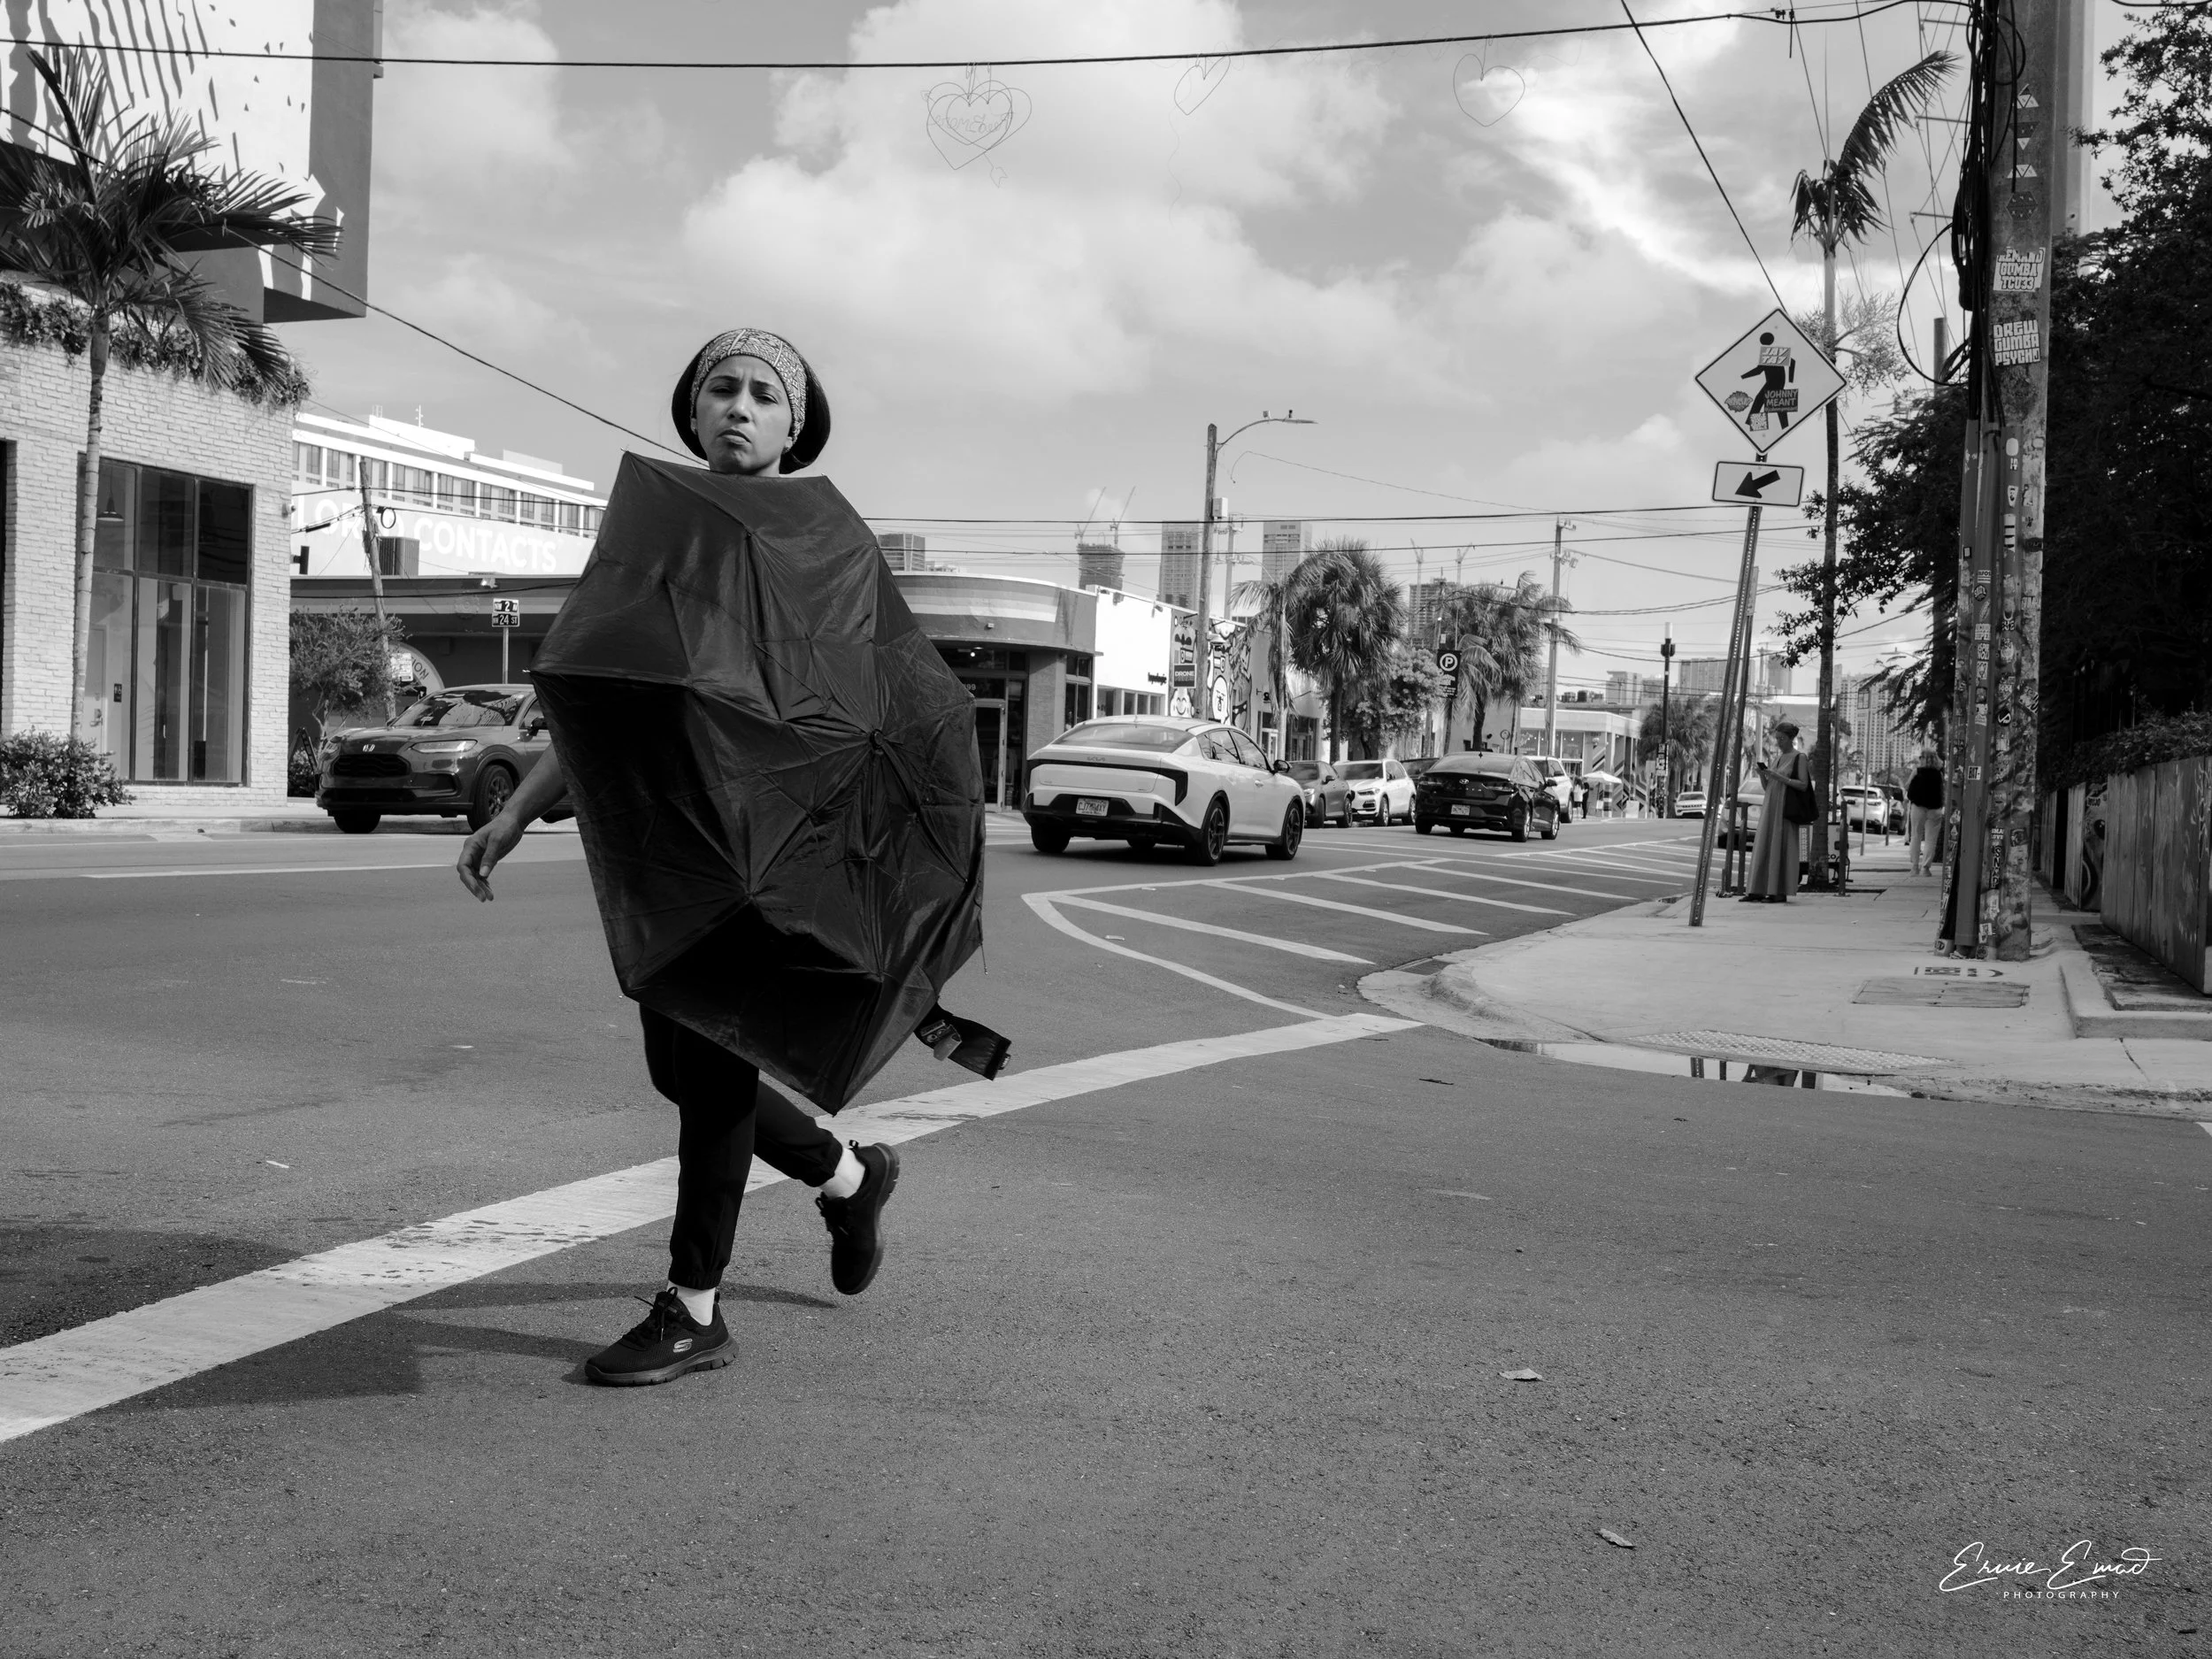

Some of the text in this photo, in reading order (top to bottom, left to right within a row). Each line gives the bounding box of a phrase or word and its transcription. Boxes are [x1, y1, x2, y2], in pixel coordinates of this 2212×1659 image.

[1993, 319, 2039, 338] DREW
[1993, 334, 2039, 352] GUMBA
[1994, 348, 2040, 366] PSYCHO
[1764, 389, 1798, 398] JOHNNY
[1766, 398, 1796, 407] MEANT
[413, 518, 557, 573] CONTACTS
[499, 614, 510, 626] 24
[411, 657, 429, 680] ION
